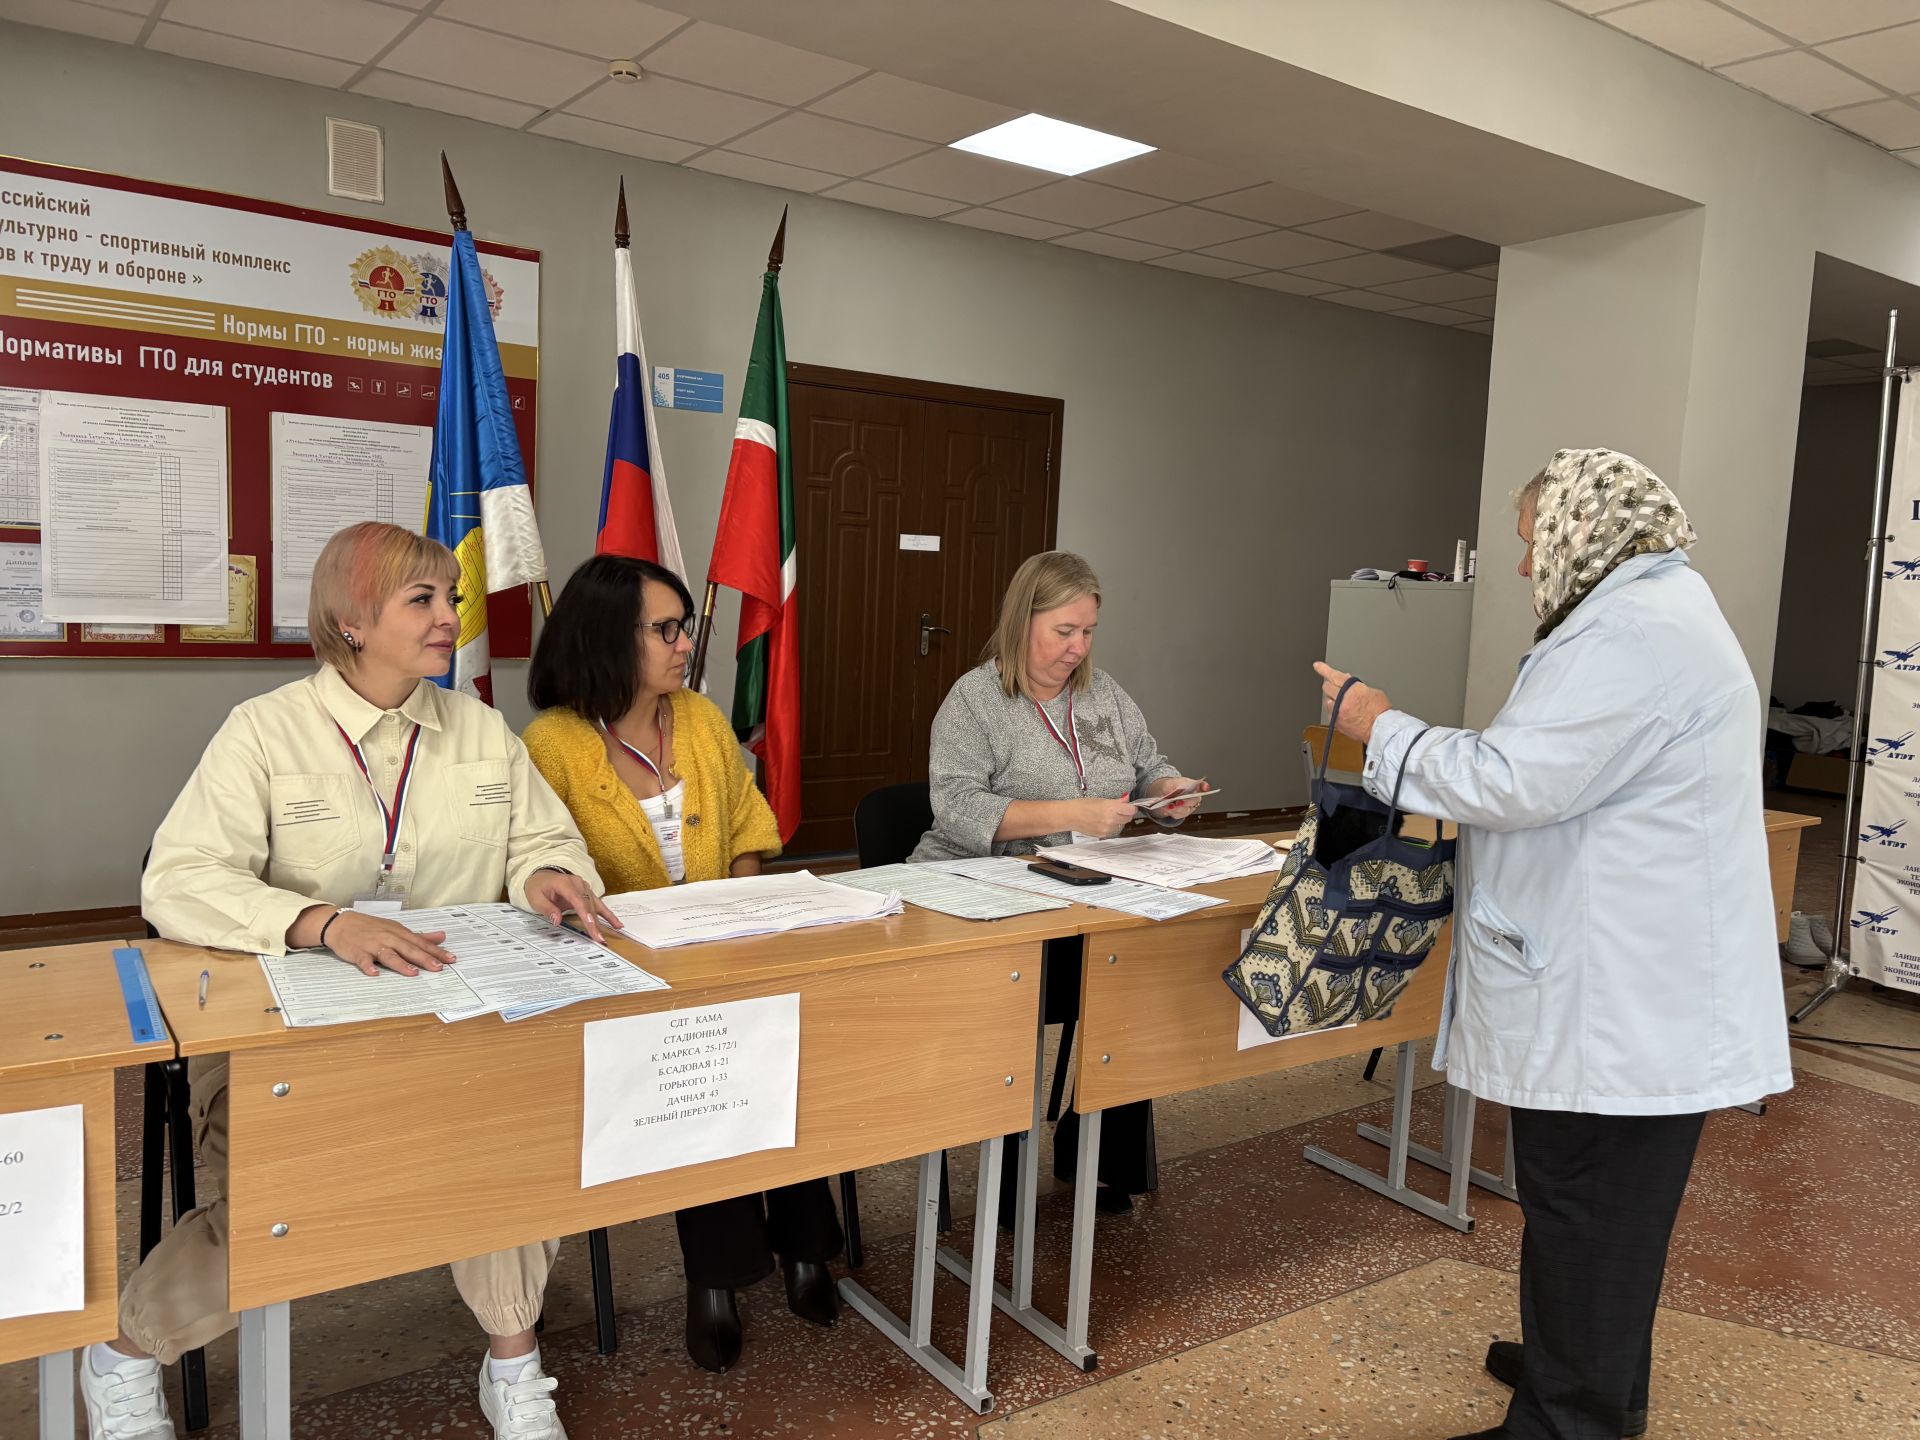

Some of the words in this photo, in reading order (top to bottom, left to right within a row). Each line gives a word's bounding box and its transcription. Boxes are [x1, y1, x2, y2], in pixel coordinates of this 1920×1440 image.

[100, 233, 205, 261] спортивный
[212, 250, 291, 274] комплекс
[24, 250, 34, 264] к
[40, 252, 91, 276] труду
[98, 260, 108, 274] и
[115, 260, 186, 284] обороне
[377, 289, 397, 299] ГТО
[420, 295, 438, 305] ГТО
[384, 302, 390, 310] 1
[426, 308, 431, 316] 1
[223, 313, 287, 341] Нормы
[295, 323, 326, 346] ГТО
[347, 335, 404, 357] нормы
[0, 330, 122, 366] ормативы
[139, 345, 177, 372] ГТО
[184, 357, 223, 377] для
[231, 360, 333, 389] студентов
[658, 372, 670, 380] 405
[670, 1017, 689, 1028] СДТ
[695, 1012, 723, 1025] КАМА
[663, 1027, 728, 1045] СТАДИОННАЯ
[651, 1053, 660, 1062] К.
[662, 1047, 701, 1061] МАРКСА
[705, 1041, 737, 1053] 25-172/1
[658, 1060, 711, 1076] Б.САДОВАЯ
[713, 1057, 729, 1068] 1-21
[659, 1076, 707, 1092] ГОРЬКОГО
[711, 1073, 728, 1083] 1-33
[666, 1091, 705, 1107] ДАЧНАЯ
[709, 1089, 719, 1098] 43
[633, 1110, 678, 1127] ЗЕЛЕНЫЙ
[680, 1102, 728, 1119] ПЕРЕУЛОК
[732, 1098, 749, 1109] 1-34
